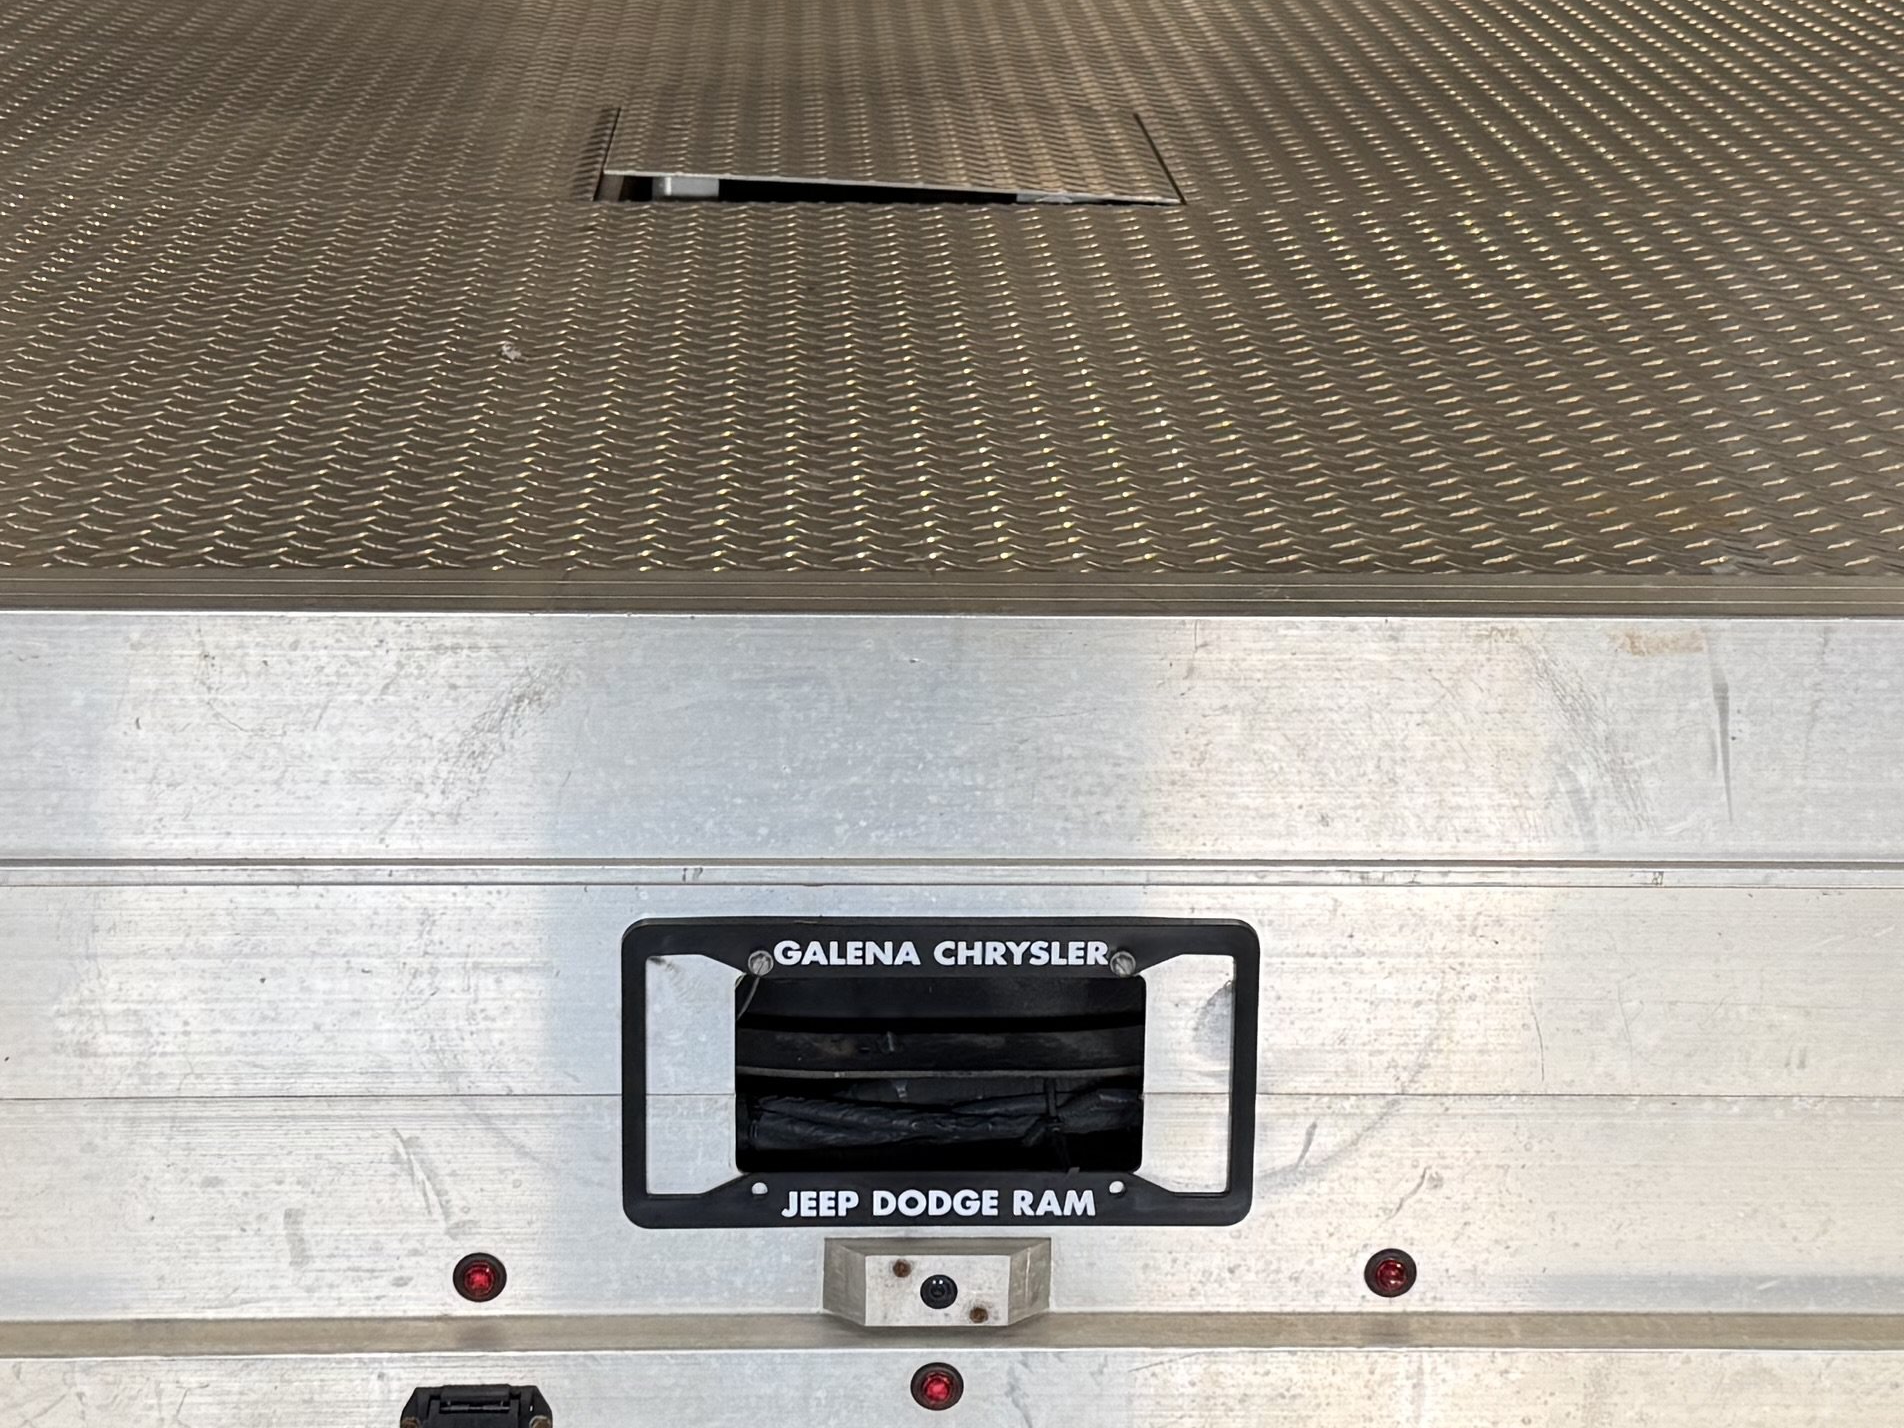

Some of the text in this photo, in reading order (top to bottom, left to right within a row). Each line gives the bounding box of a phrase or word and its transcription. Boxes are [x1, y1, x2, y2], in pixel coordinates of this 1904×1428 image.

[773, 940, 1109, 967] GALENA CHRYSLER
[781, 1189, 1096, 1218] JEEP DODGE RAM
